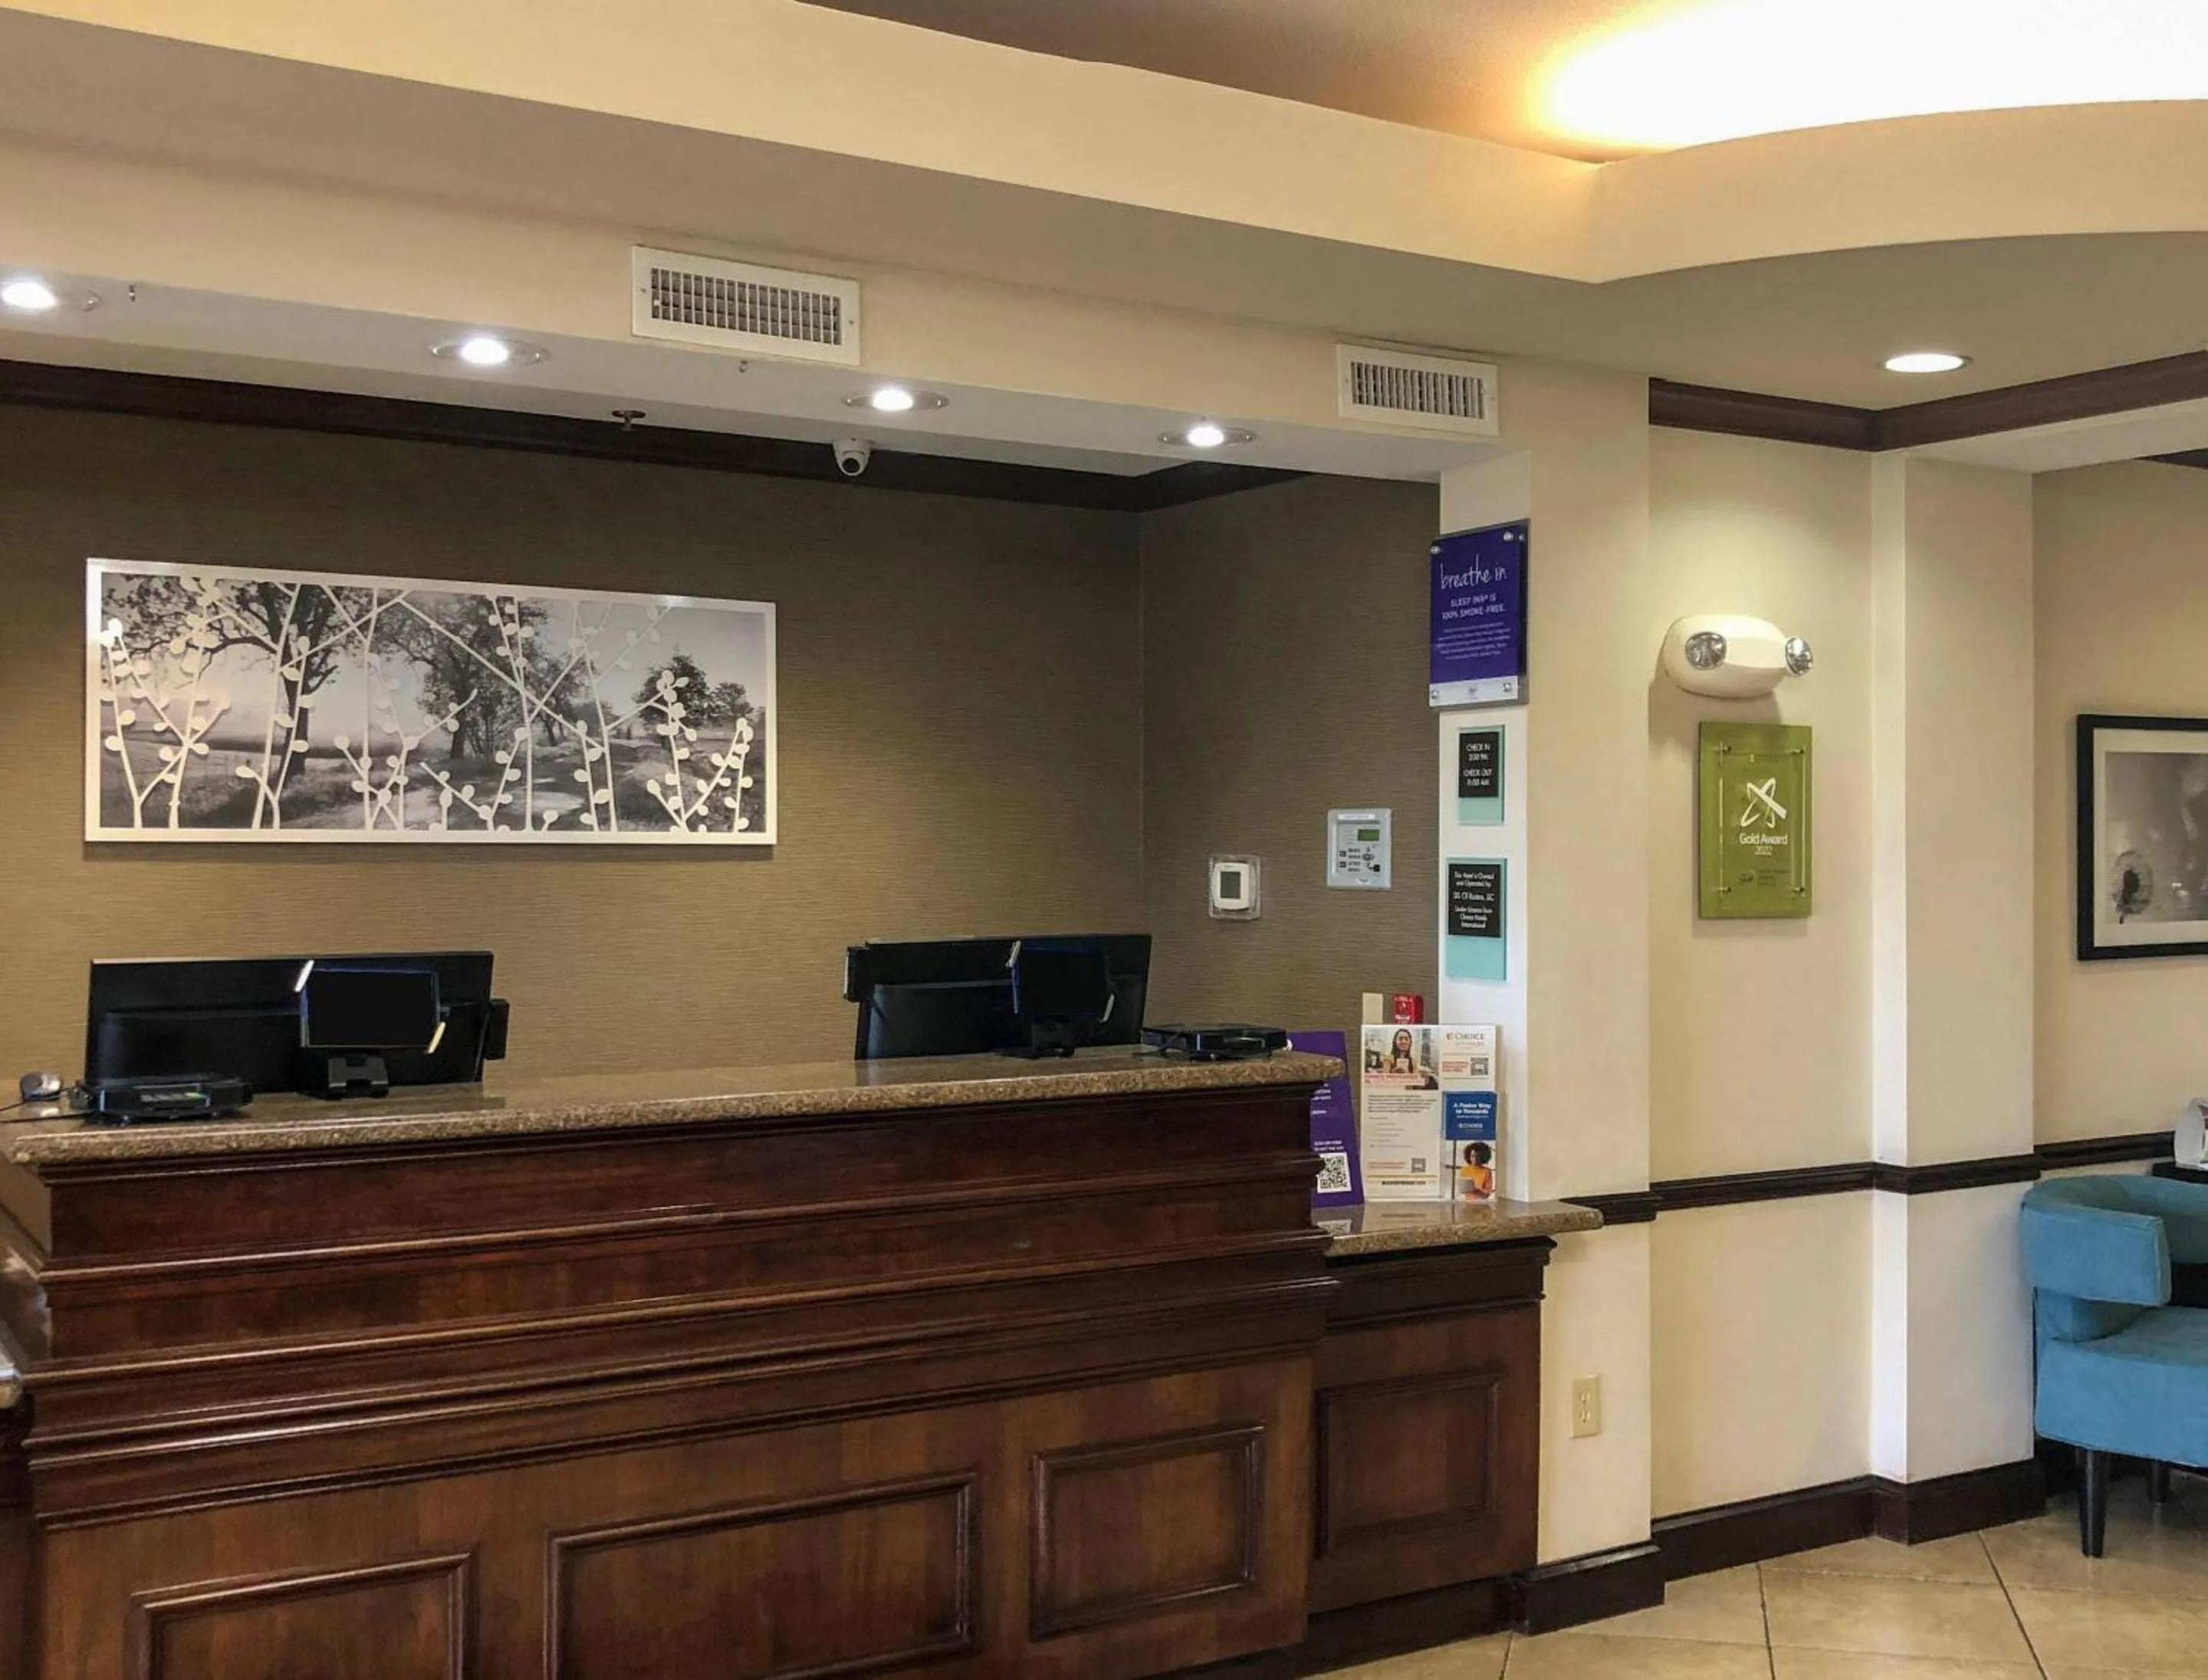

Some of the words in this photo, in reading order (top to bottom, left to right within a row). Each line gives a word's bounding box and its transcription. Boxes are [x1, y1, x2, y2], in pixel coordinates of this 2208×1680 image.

[1441, 553, 1491, 589] breathe
[1495, 565, 1507, 581] in
[1451, 597, 1471, 607] SLEEP
[1441, 611, 1459, 620] 100%
[1466, 743, 1484, 751] CHECK
[1739, 832, 1760, 845] Gold
[1760, 832, 1788, 845] Award
